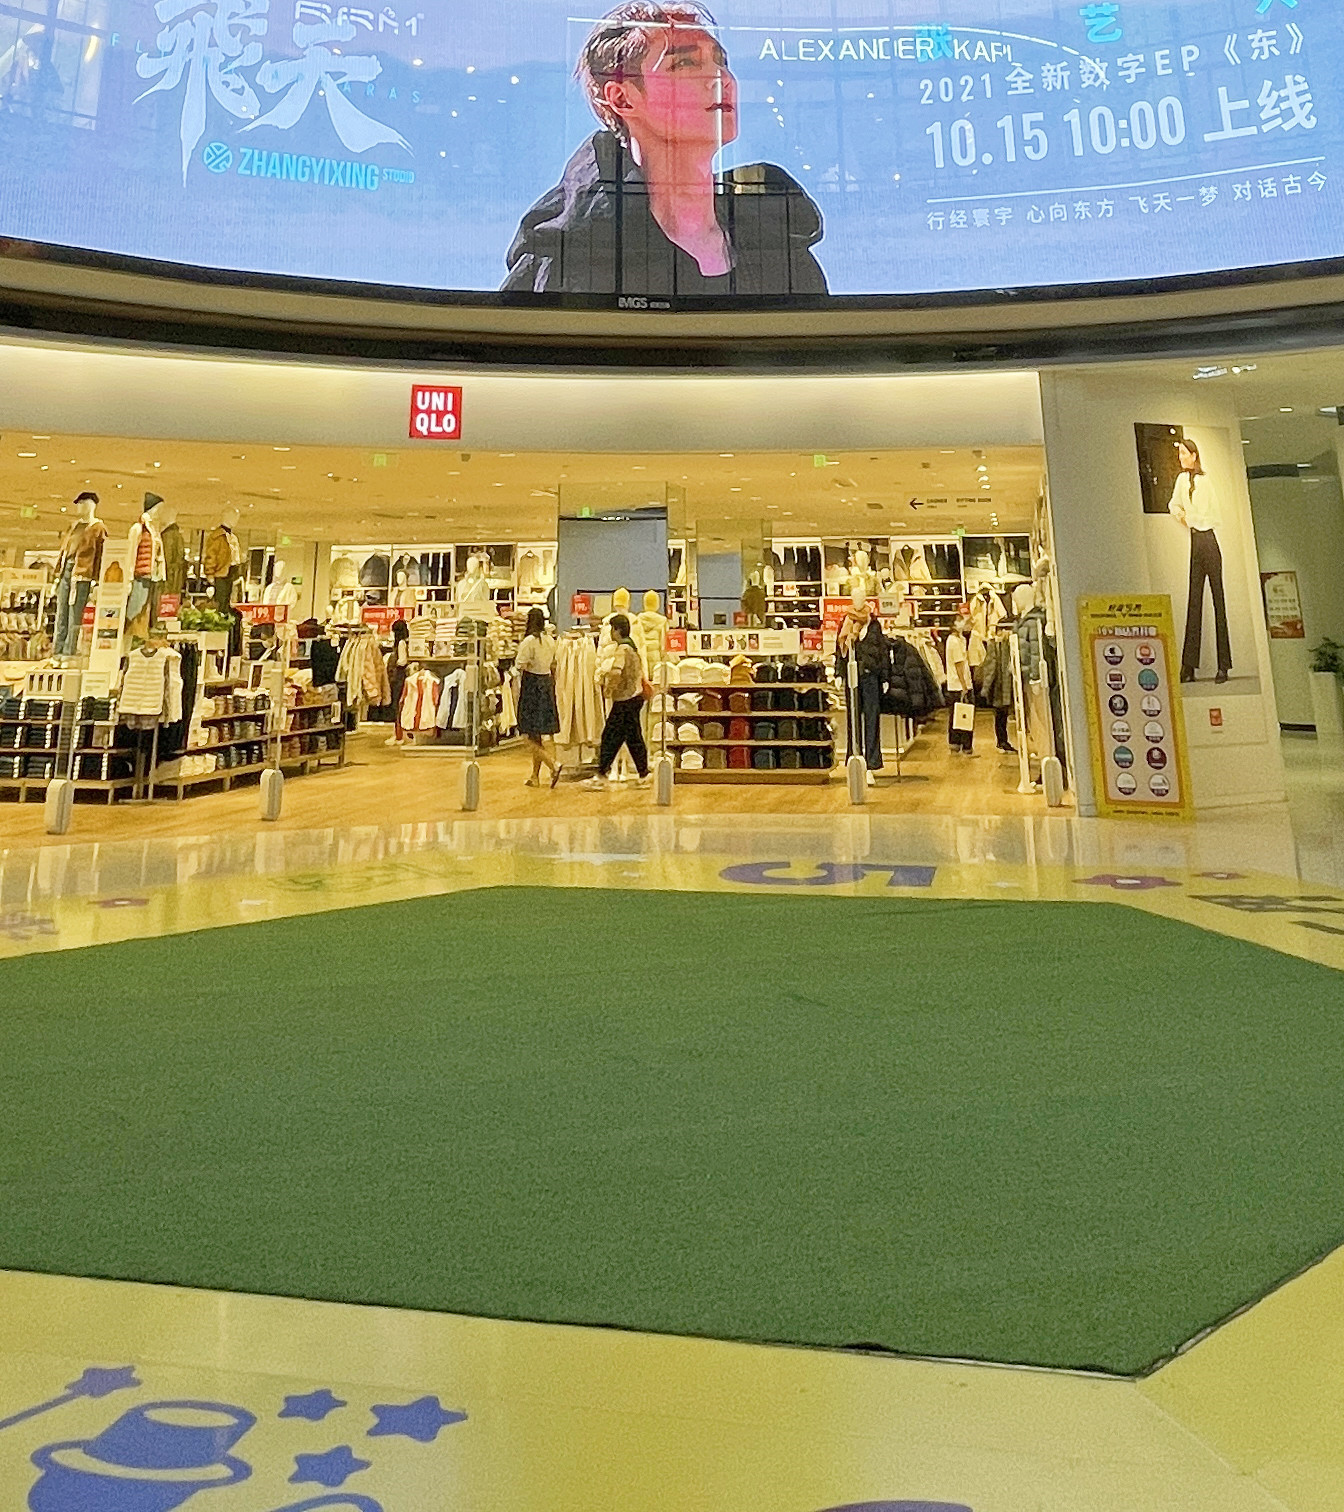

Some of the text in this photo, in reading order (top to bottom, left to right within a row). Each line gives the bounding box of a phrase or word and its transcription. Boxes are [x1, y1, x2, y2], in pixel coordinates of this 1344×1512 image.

[925, 73, 1318, 169] 10.15 10:00 上线
[237, 147, 379, 192] ZHANGYIXING
[416, 391, 454, 411] UNI
[414, 412, 456, 435] QLO
